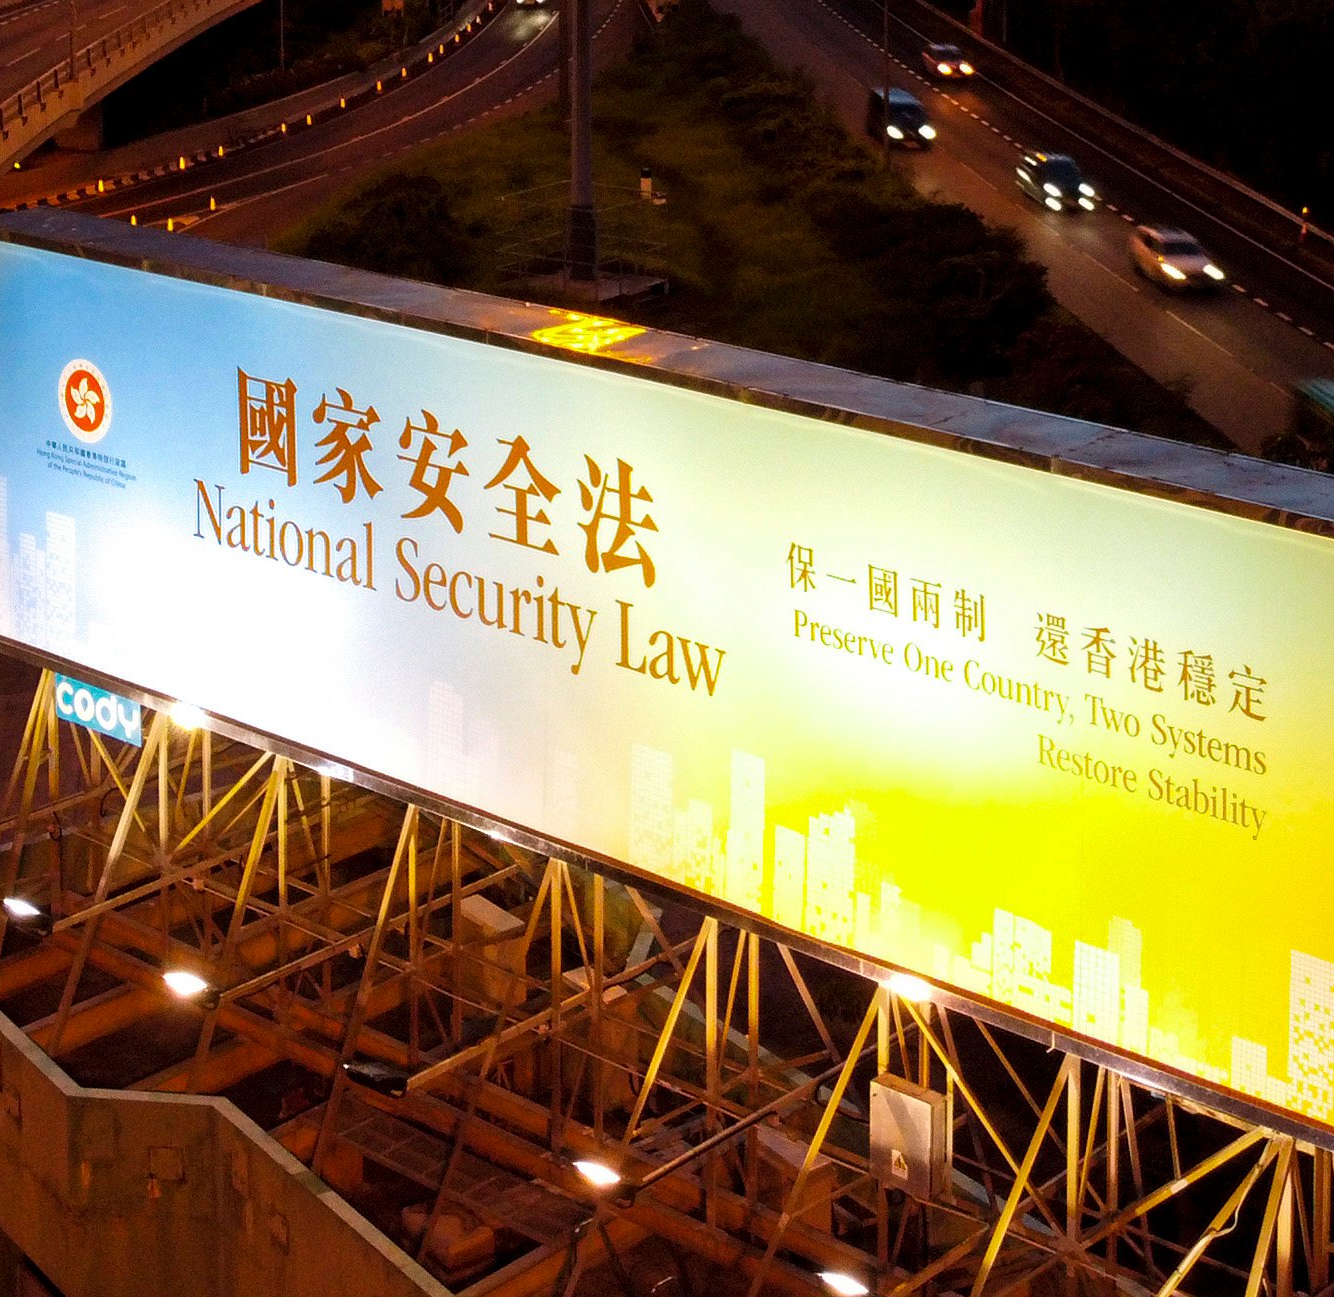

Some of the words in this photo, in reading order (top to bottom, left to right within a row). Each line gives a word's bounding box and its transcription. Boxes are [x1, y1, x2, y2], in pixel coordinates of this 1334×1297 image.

[236, 366, 659, 588] 國家安全法
[193, 478, 376, 591] National
[395, 537, 598, 675] Security
[615, 599, 726, 696] Law
[785, 541, 986, 643] 保一國兩制
[1033, 612, 1267, 722] 還香港穩定
[56, 681, 139, 739] cody
[793, 609, 895, 665] Preserve
[903, 642, 955, 683] One
[964, 660, 1075, 726] Country,
[1083, 693, 1141, 738] Two
[1150, 713, 1267, 776] Systems
[1036, 734, 1138, 794] Restore
[1147, 768, 1268, 841] Stability
